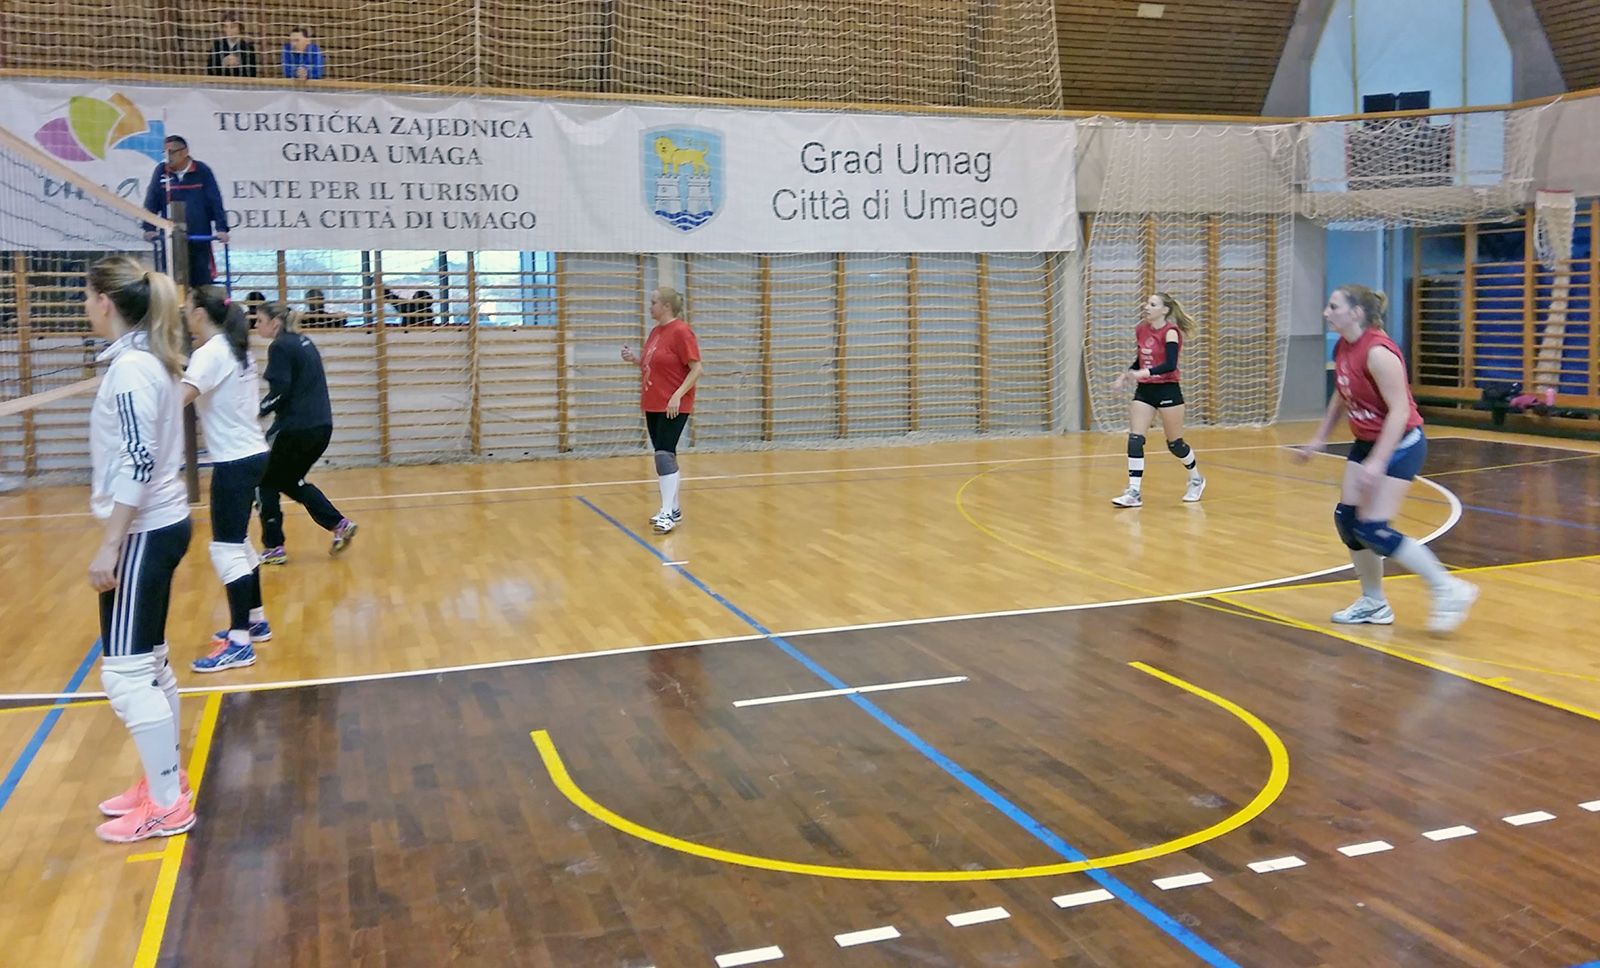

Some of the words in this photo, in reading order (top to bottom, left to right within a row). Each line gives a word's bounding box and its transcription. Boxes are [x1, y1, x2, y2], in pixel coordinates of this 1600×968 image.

[214, 110, 382, 134] TURISTIČKA
[390, 116, 533, 141] ZAJEDNICA
[282, 142, 379, 163] GRADA
[386, 145, 483, 165] UMAGA
[801, 142, 882, 174] Grad
[897, 143, 991, 182] Umag
[232, 180, 302, 199] ENTE
[309, 181, 360, 200] PER
[369, 182, 394, 200] IL
[401, 183, 519, 202] TURISMO
[226, 209, 311, 229] DELLA
[319, 206, 396, 229] CITTÀ
[402, 211, 433, 229] DI
[441, 211, 537, 230] UMAGO
[773, 188, 850, 220] Città
[863, 189, 889, 220] di
[904, 189, 1018, 227] Umago
